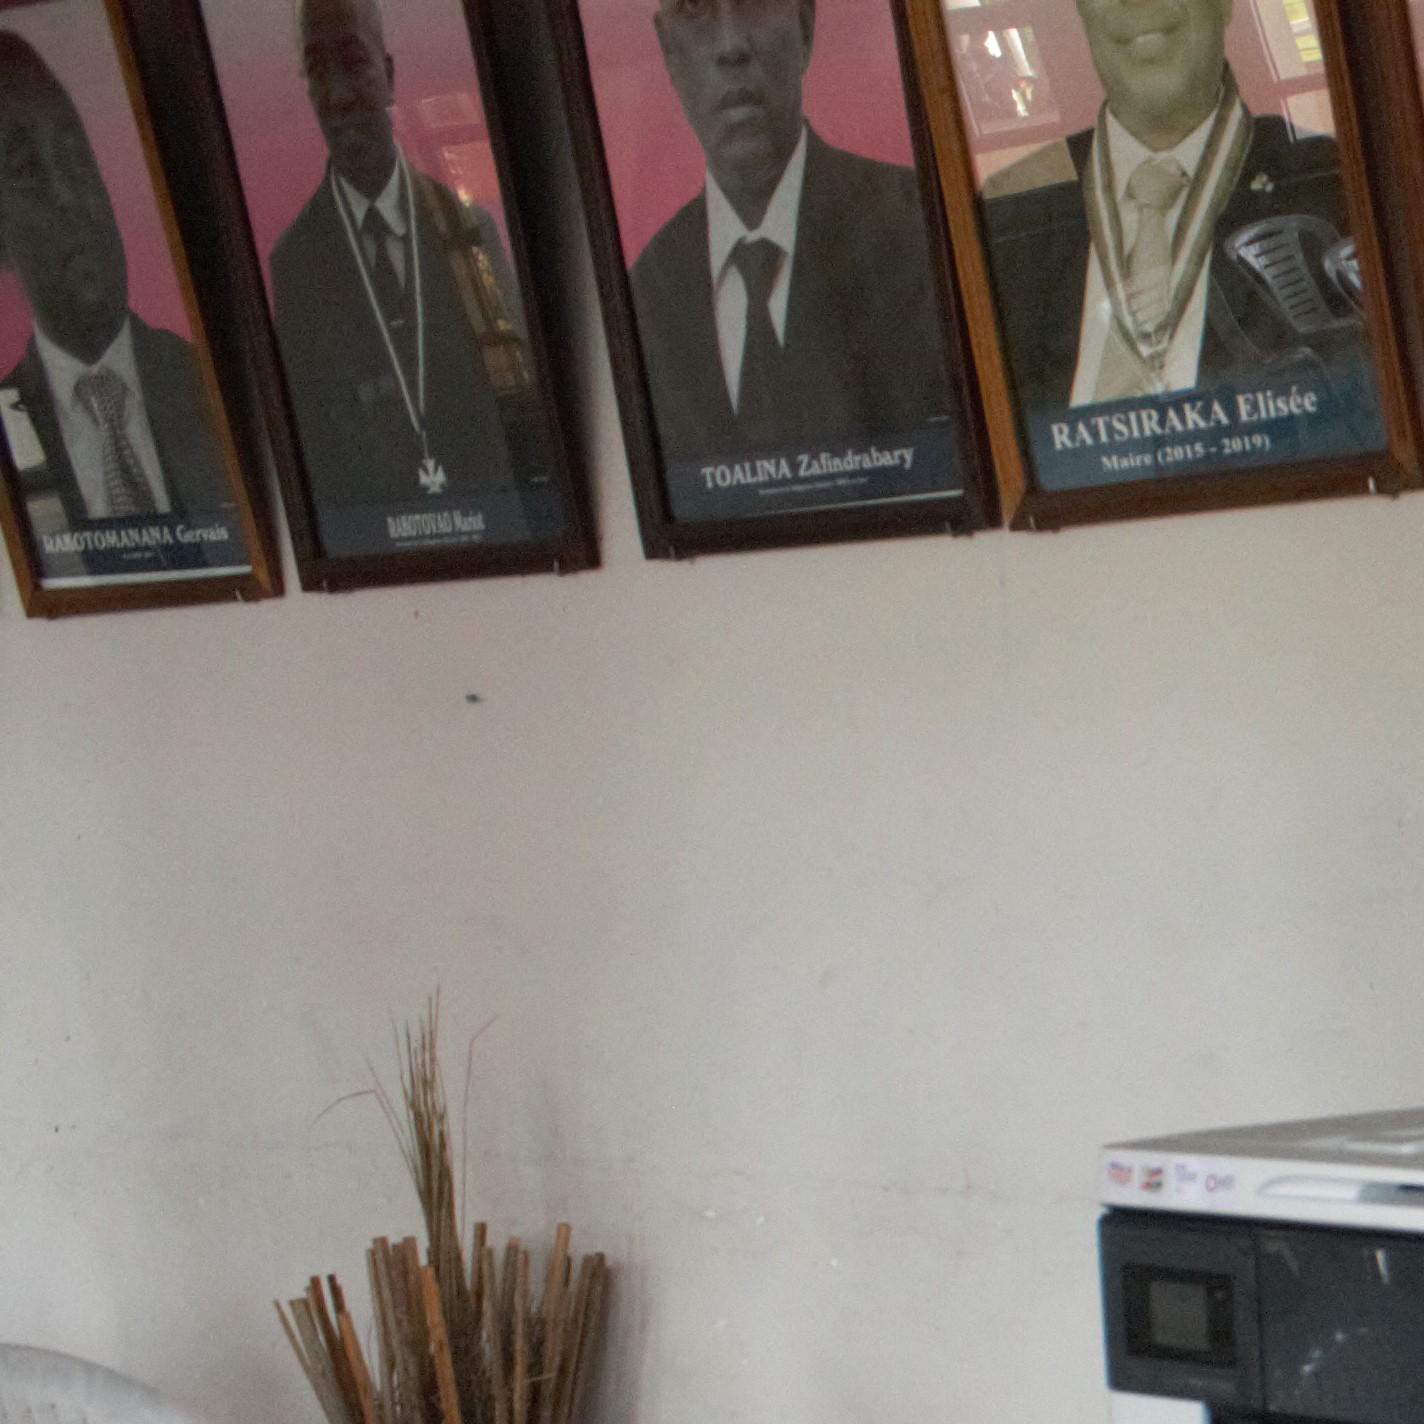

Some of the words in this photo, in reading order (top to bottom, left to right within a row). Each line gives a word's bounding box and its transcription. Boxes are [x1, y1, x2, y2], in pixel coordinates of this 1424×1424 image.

[1051, 399, 1230, 450] RATSIRAKA
[1236, 384, 1319, 424] Elisée
[701, 456, 792, 489] TOALINA
[1101, 449, 1151, 472] Maire
